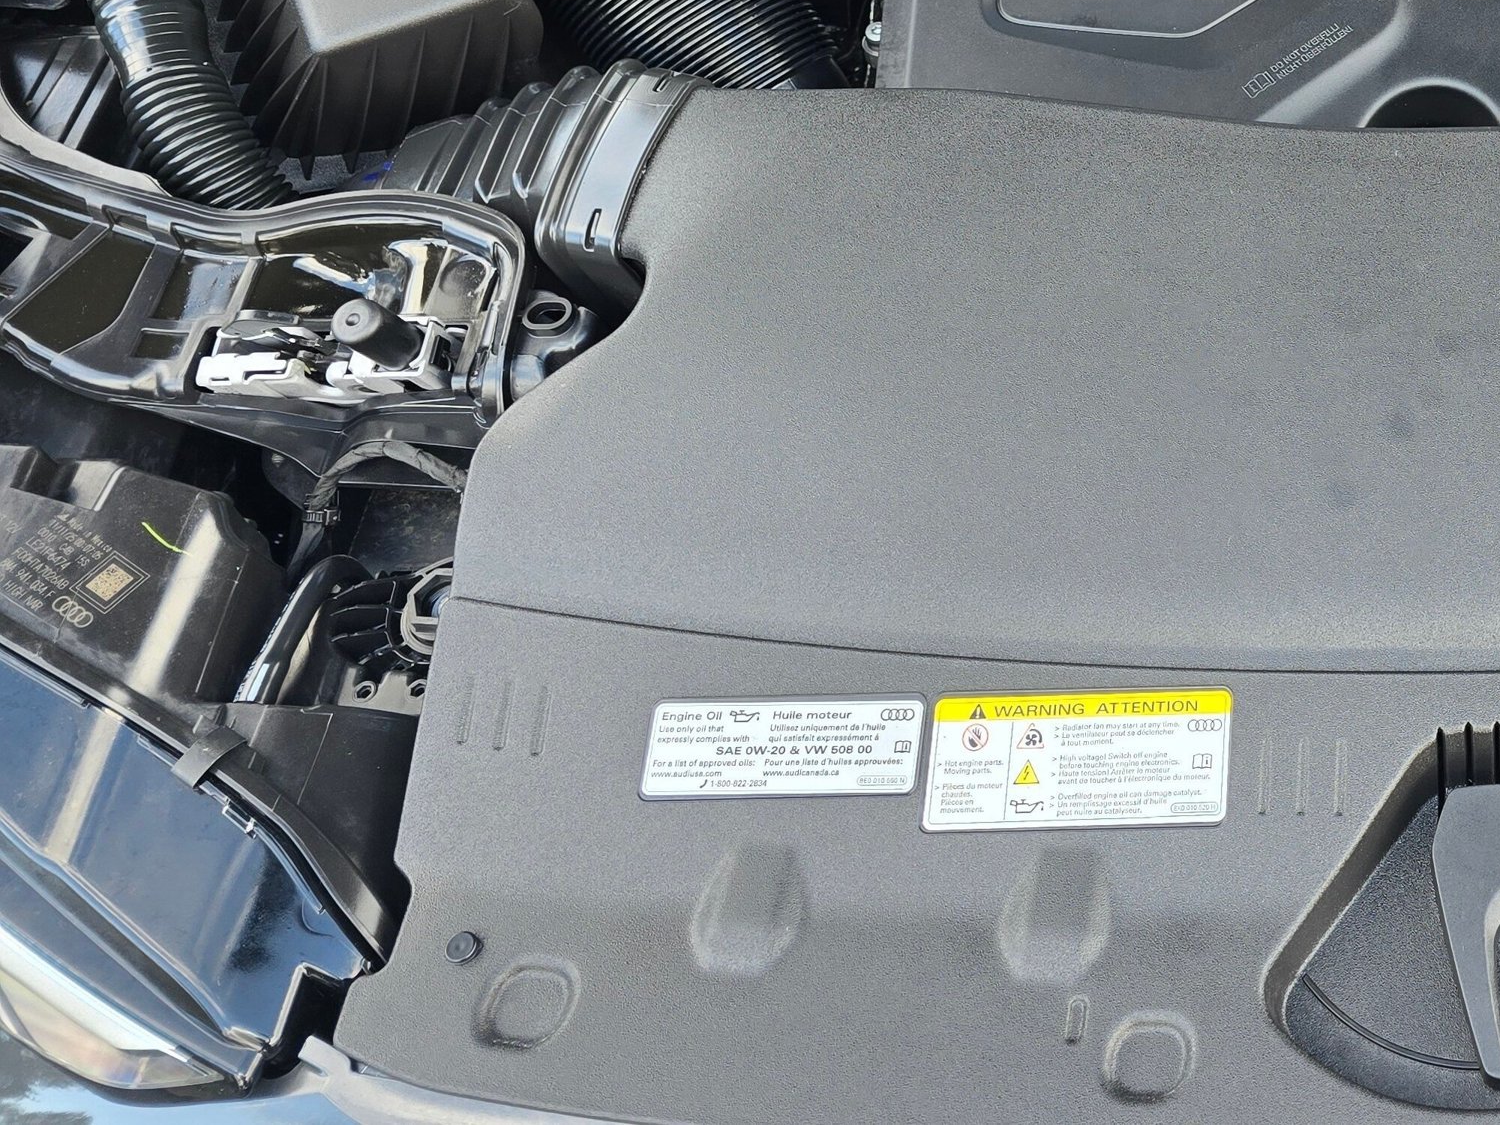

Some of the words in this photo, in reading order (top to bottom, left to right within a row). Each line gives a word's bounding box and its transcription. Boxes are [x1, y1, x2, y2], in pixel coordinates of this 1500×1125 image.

[1270, 60, 1285, 73] DO
[1282, 49, 1301, 64] NOT
[1276, 60, 1304, 80] NICHT
[994, 704, 1084, 716] WARNING
[1096, 700, 1197, 713] ATTENTION
[662, 711, 702, 722] Engine
[706, 711, 722, 720] Oil
[772, 710, 802, 719] Huile
[806, 711, 852, 719] moteur
[676, 725, 694, 733] only
[800, 723, 848, 732] uniquement
[1062, 723, 1090, 731] Radiator
[657, 735, 694, 744] expressly
[695, 735, 730, 743] complies
[768, 735, 781, 743] qui
[816, 734, 872, 742] expressément
[715, 746, 741, 755] SAE
[745, 745, 785, 755] 0W-20
[789, 745, 799, 754] &
[804, 745, 827, 754] VW
[831, 745, 853, 754] 508
[857, 744, 872, 753] 00
[1060, 754, 1076, 762] High
[1144, 751, 1167, 759] engine
[652, 759, 665, 767] For
[674, 759, 686, 767] list
[688, 759, 697, 767] of
[699, 759, 736, 768] approved
[764, 758, 782, 766] Pour
[801, 758, 818, 766] liste
[958, 759, 982, 767] engine
[984, 759, 1003, 767] parts.
[1083, 760, 1113, 768] touching
[972, 767, 992, 775] parts.
[710, 779, 767, 787] 1-800-822-2834
[1057, 792, 1091, 800] Overfilled
[1093, 792, 1116, 800] engine
[1143, 790, 1172, 798] damage
[1069, 800, 1111, 809] remplissage
[1056, 809, 1072, 817] peut
